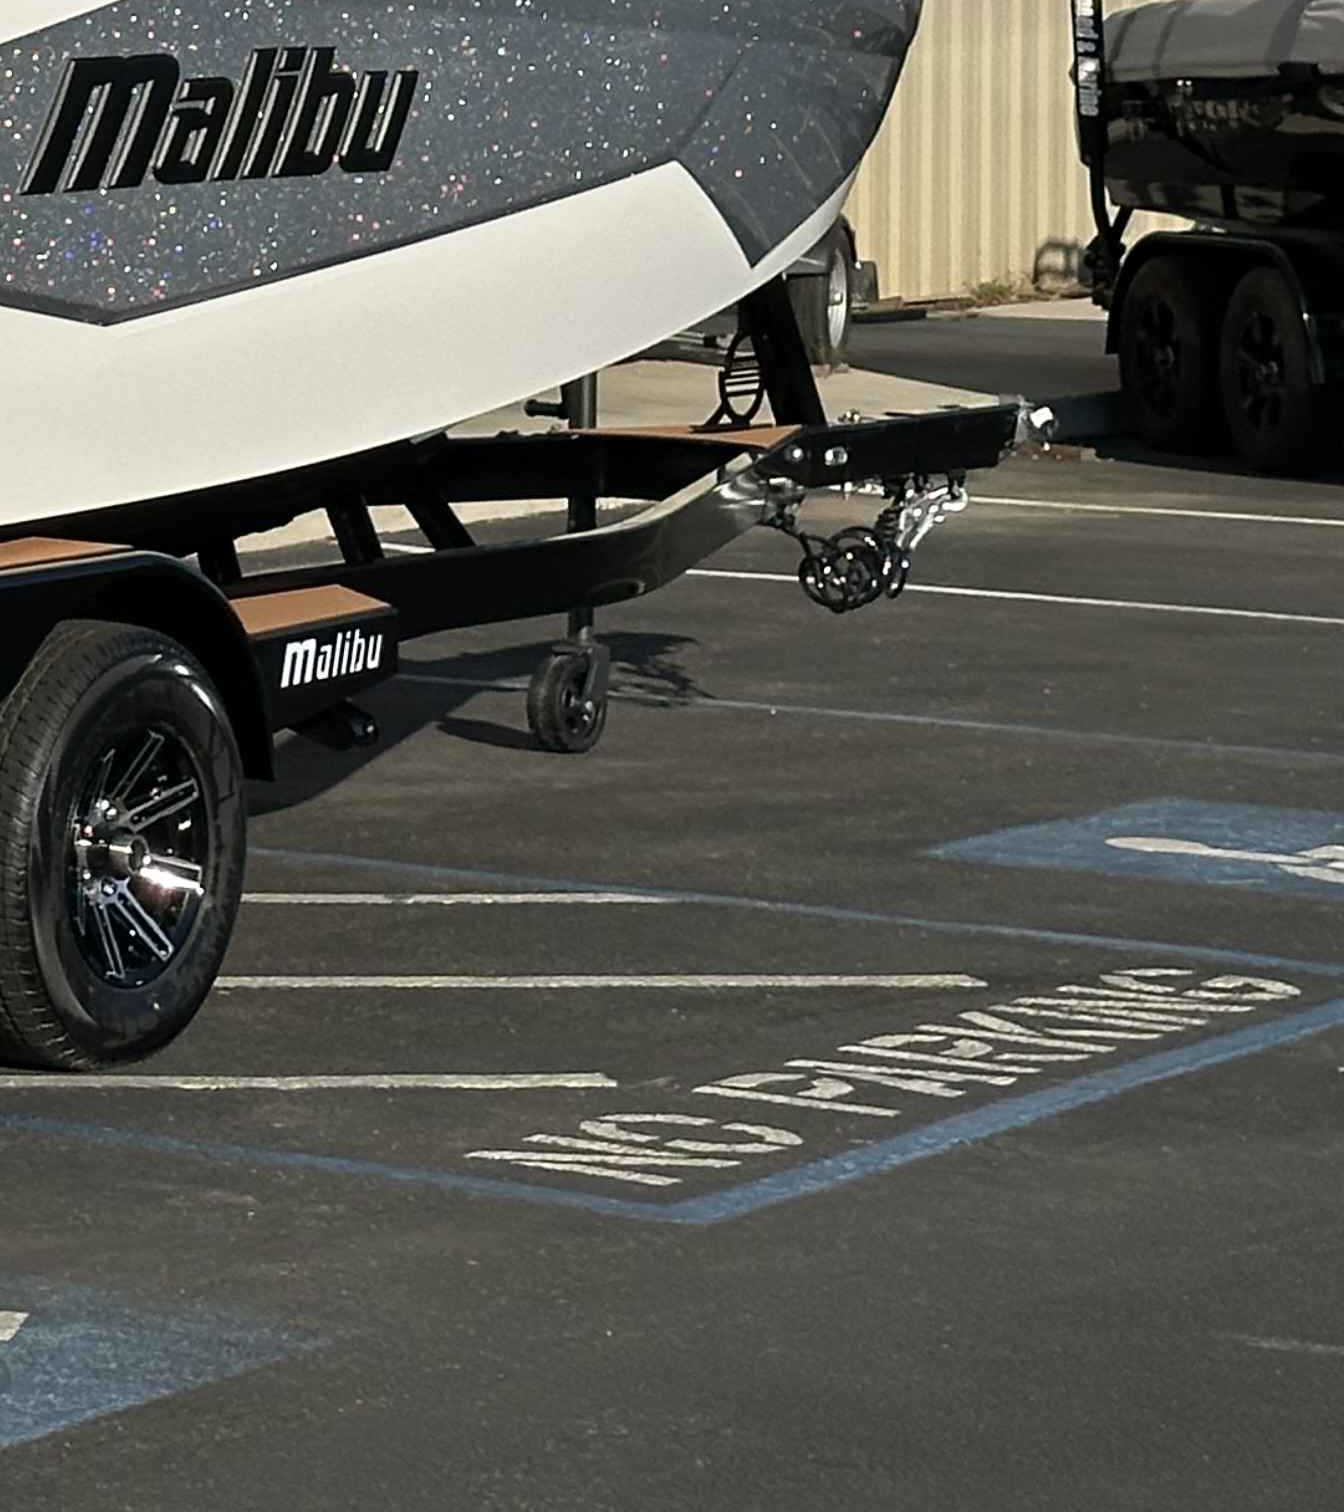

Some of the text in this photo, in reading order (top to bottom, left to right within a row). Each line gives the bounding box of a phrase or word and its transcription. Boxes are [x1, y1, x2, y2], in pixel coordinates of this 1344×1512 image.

[19, 46, 419, 196] Malibu
[280, 628, 383, 688] Malibu
[465, 967, 1302, 1187] NO PARKING
